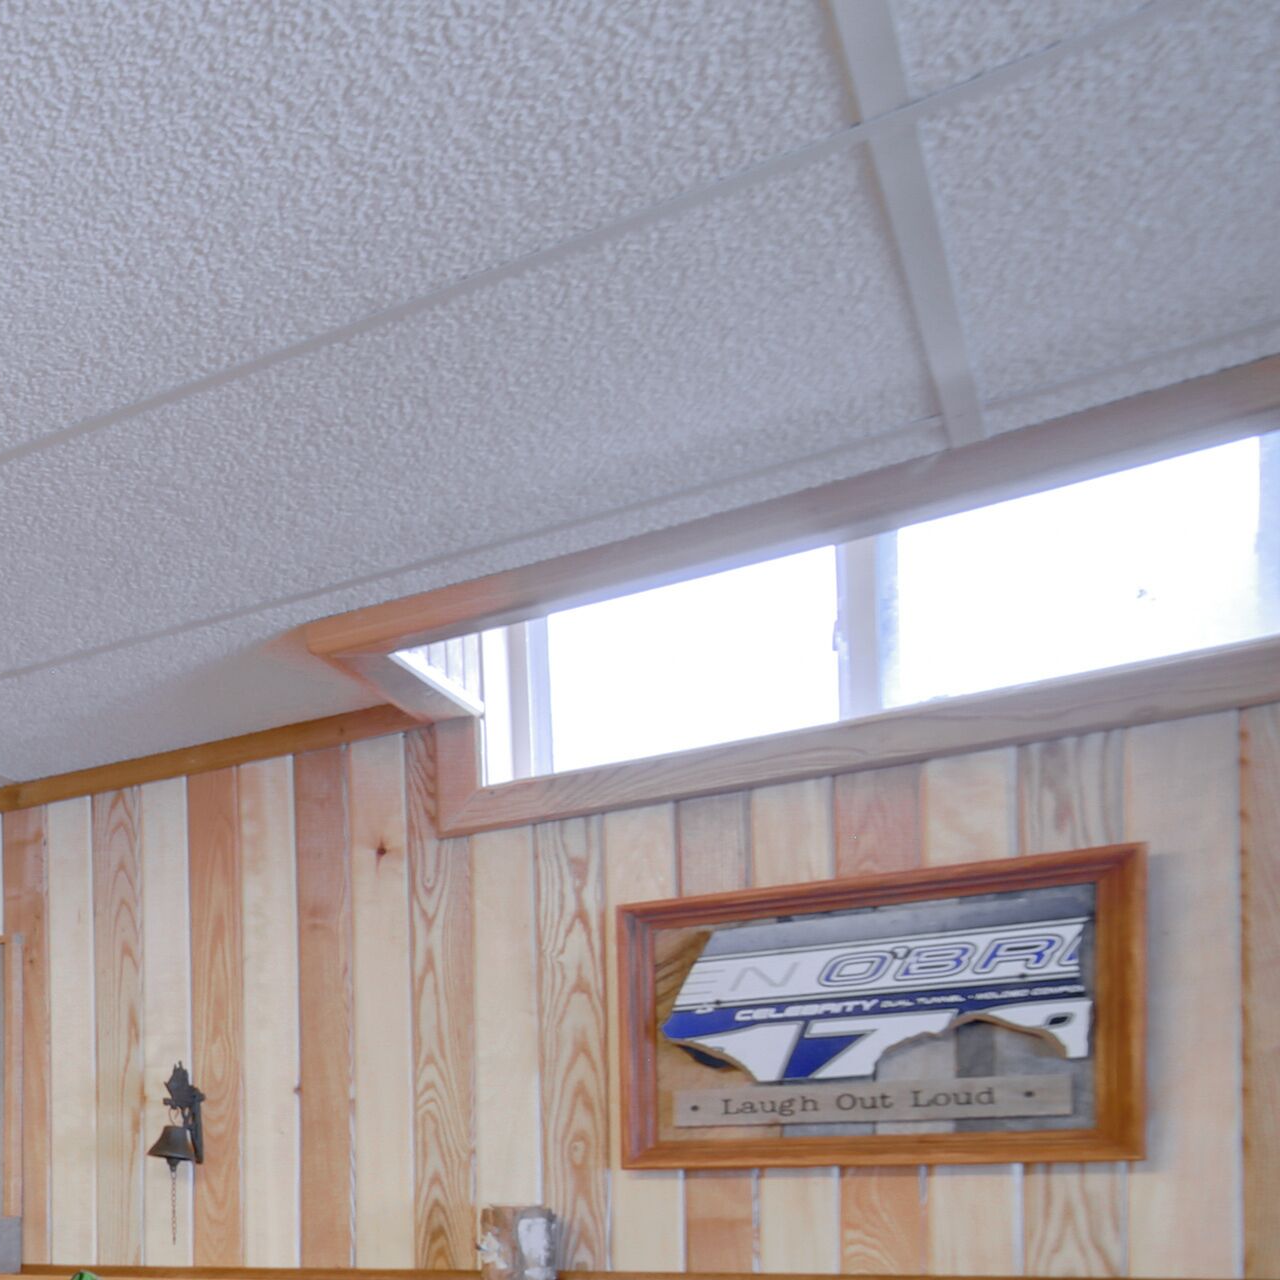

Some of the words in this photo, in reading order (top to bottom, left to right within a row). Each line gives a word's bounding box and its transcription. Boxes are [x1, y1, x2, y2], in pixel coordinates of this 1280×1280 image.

[734, 998, 880, 1022] CELEBRITY
[721, 1094, 819, 1117] Laugh
[835, 1092, 894, 1112] Out
[911, 1087, 997, 1109] Loud
